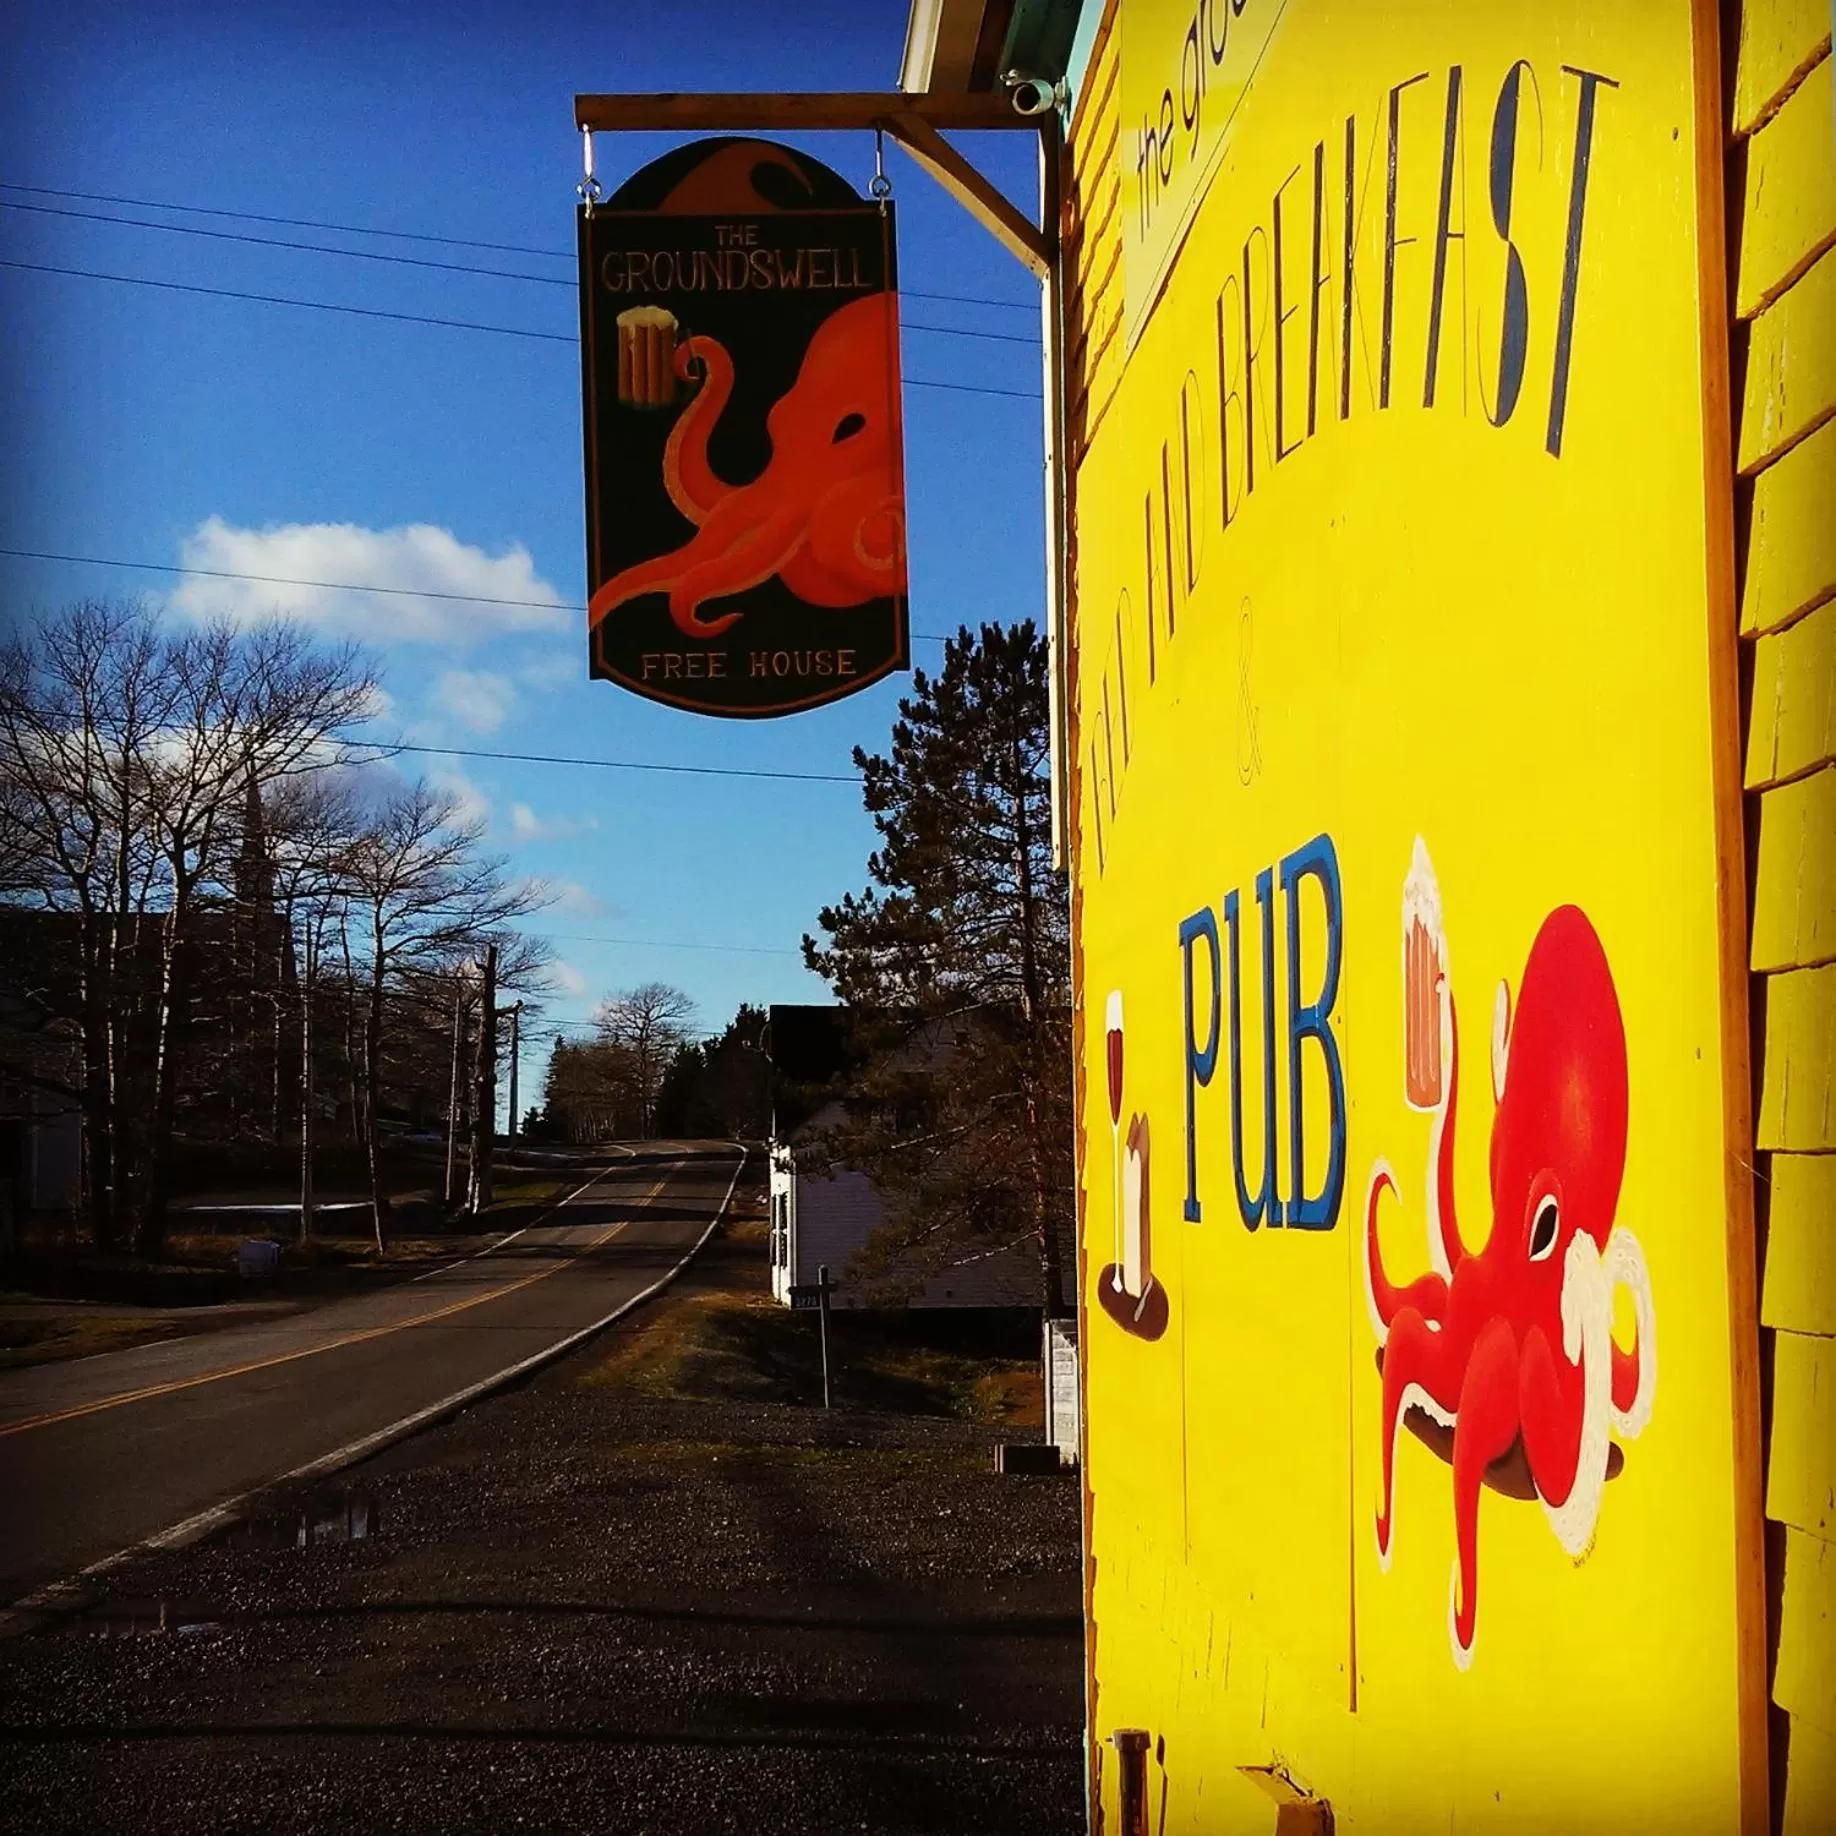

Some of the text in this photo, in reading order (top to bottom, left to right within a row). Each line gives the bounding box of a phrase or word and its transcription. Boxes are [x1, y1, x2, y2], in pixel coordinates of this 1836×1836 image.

[1137, 0, 1246, 242] the gro
[602, 248, 873, 293] GROUNDSWELL
[715, 224, 759, 245] THE
[1145, 369, 1206, 688] AND
[1216, 58, 1620, 532] BREAKFAST
[640, 649, 857, 681] FREE HOUSE
[1179, 833, 1347, 1233] PUB
